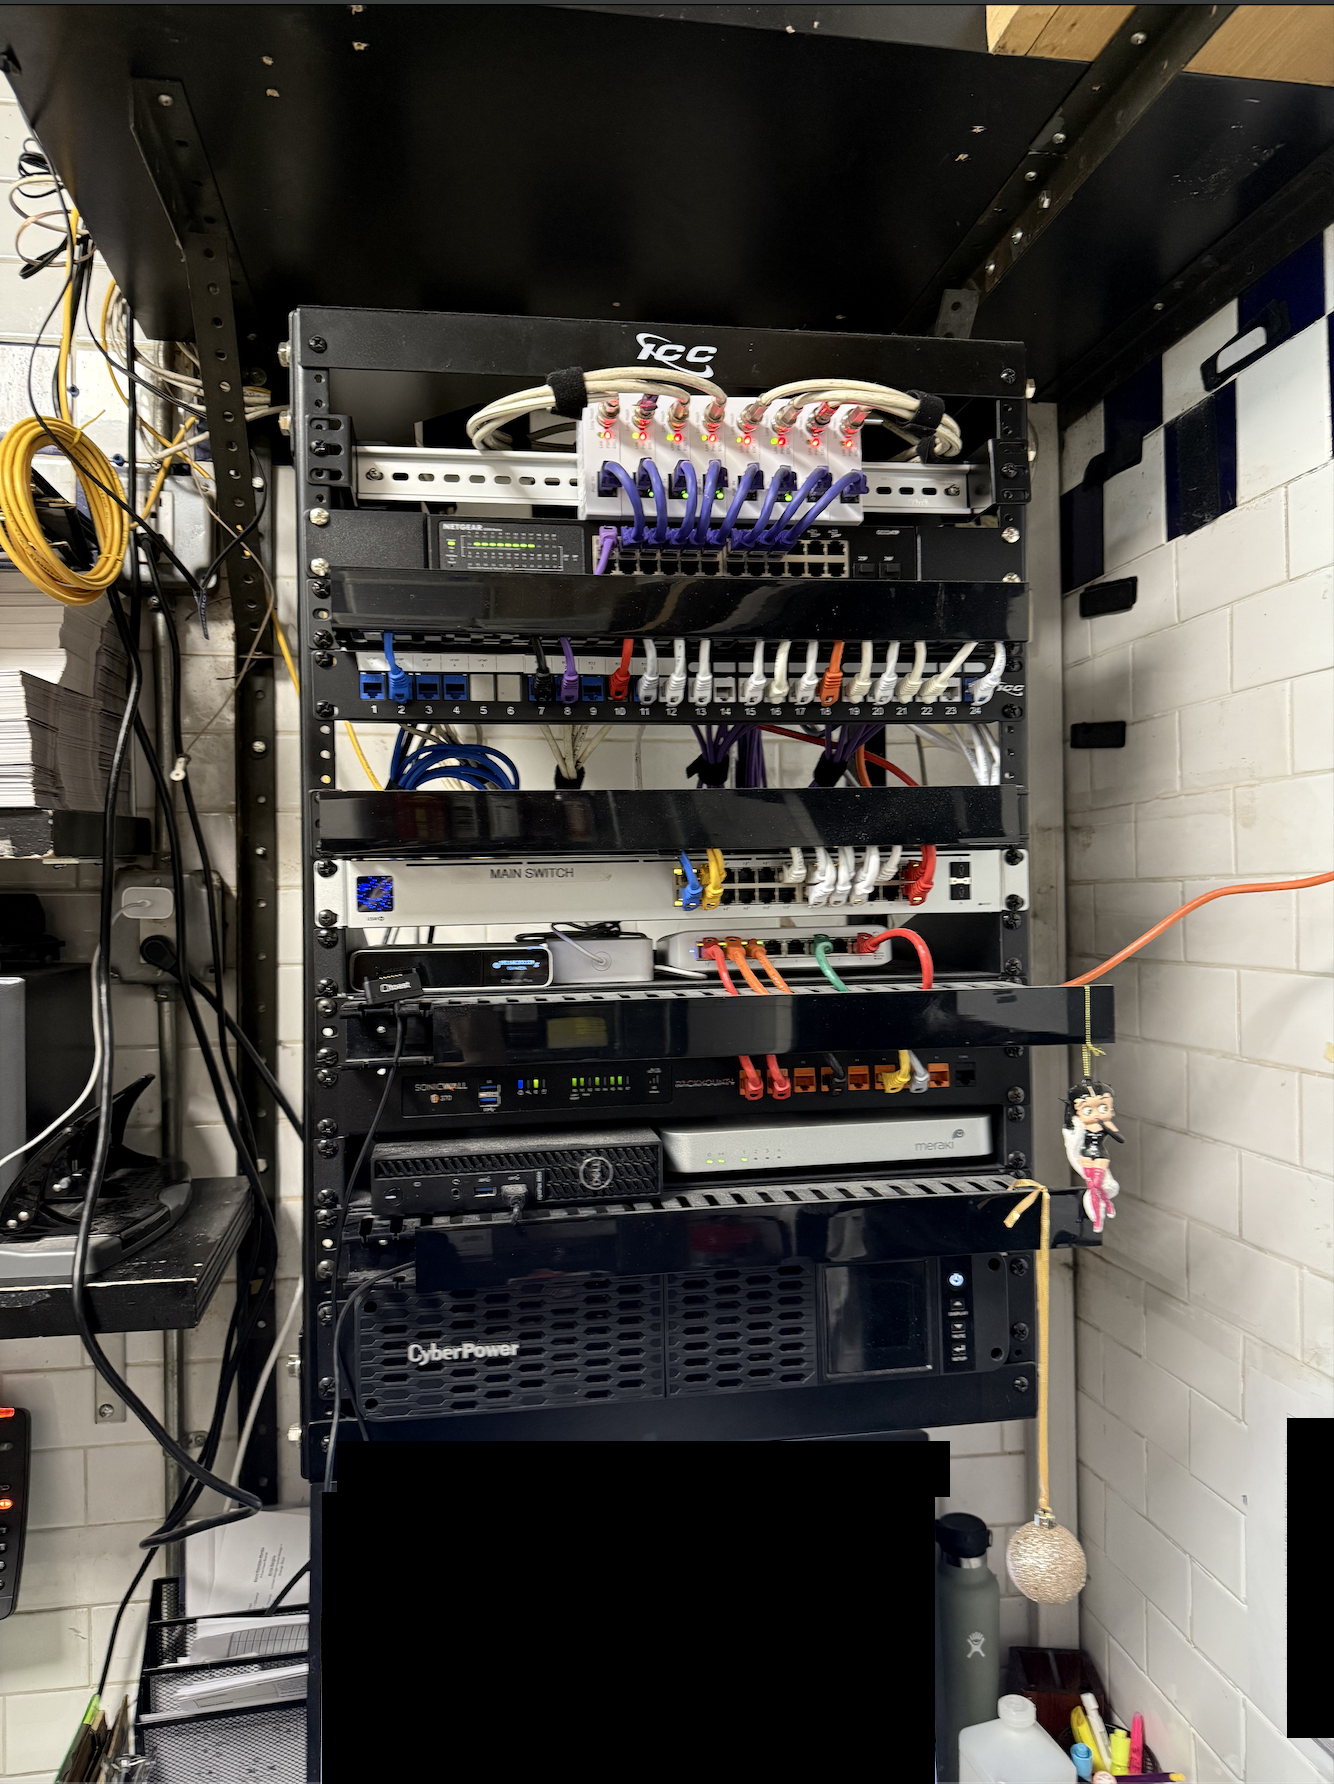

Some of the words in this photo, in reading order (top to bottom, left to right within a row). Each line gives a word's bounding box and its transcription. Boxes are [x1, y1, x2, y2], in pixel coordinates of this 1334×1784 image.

[442, 523, 483, 531] NETGEAR
[371, 705, 377, 713] 1
[398, 706, 405, 714] 2
[426, 706, 433, 714] 3
[453, 706, 460, 714] 4
[480, 706, 487, 714] 5
[507, 707, 514, 715] 6
[538, 707, 545, 715] 7
[564, 707, 571, 715] 8
[590, 707, 597, 715] 9
[614, 707, 626, 715] 10
[666, 708, 677, 716] 12
[849, 707, 860, 715] 19
[872, 707, 884, 715] 20
[896, 707, 907, 715] 21
[921, 707, 933, 715] 22
[945, 707, 957, 715] 23
[970, 707, 981, 715] 24
[490, 868, 522, 879] MAIN
[525, 867, 574, 879] SWITCH
[914, 1141, 955, 1151] meraki
[407, 1342, 520, 1366] CyberPower
